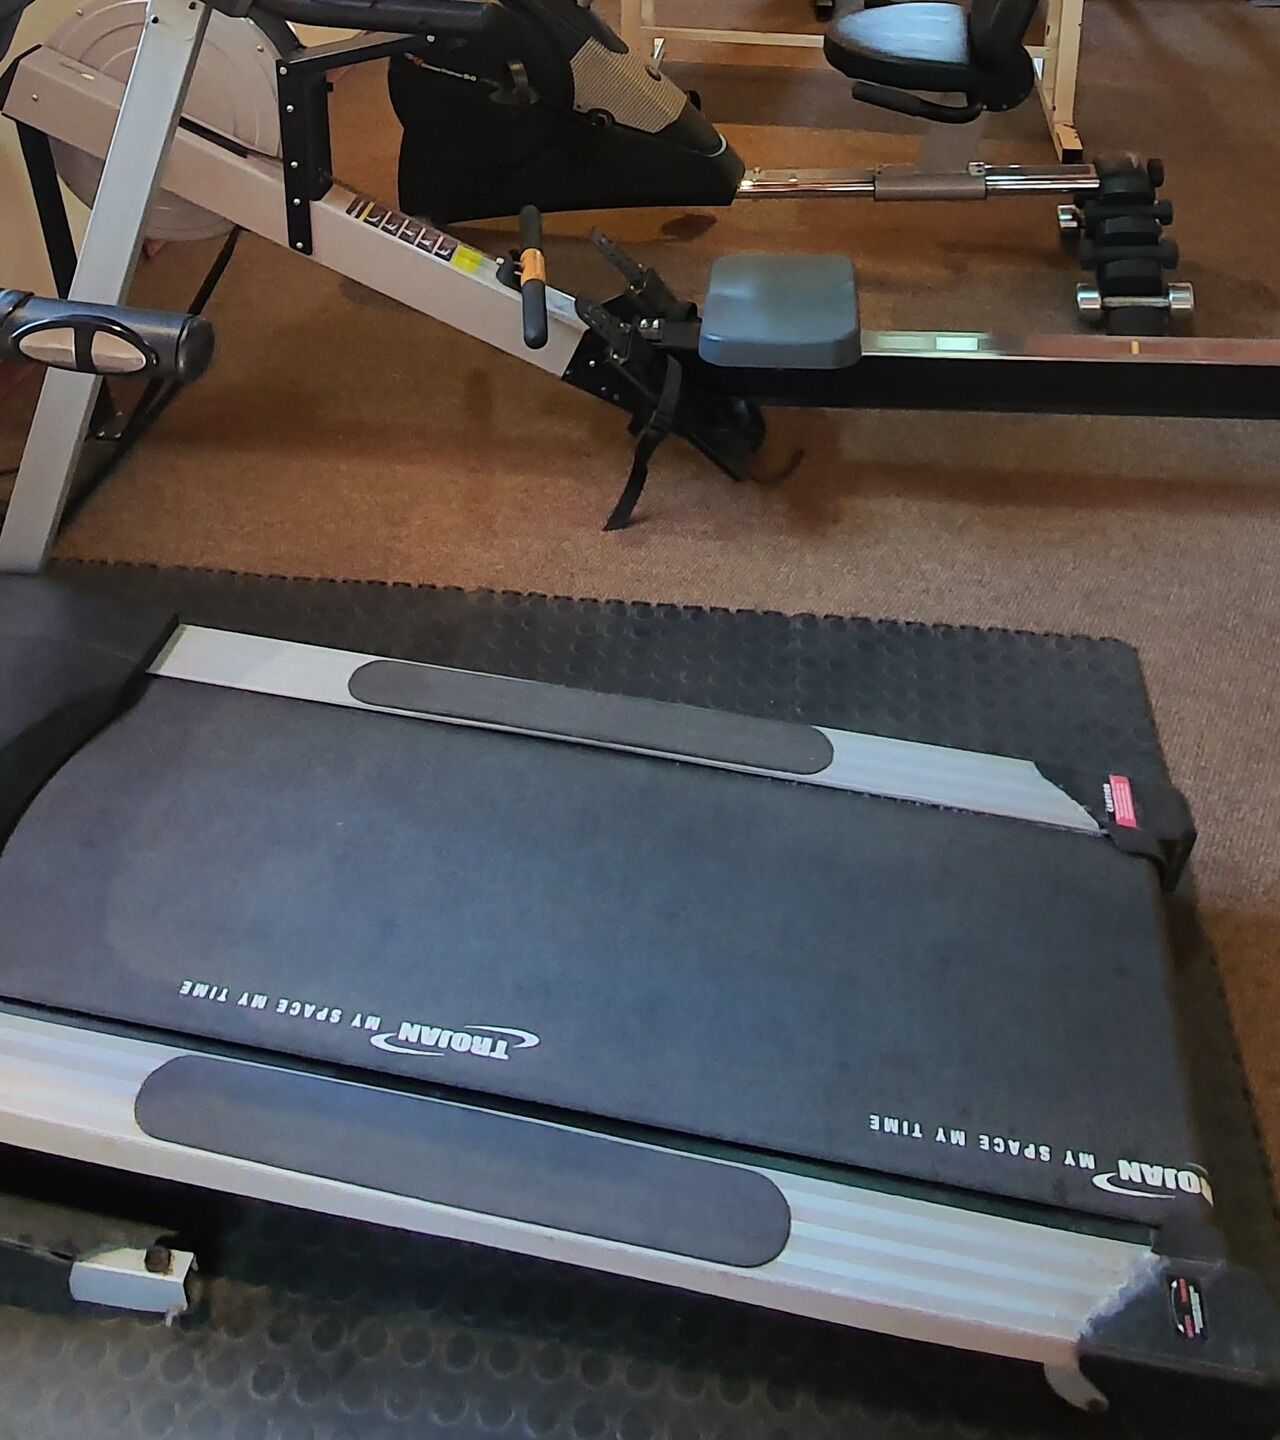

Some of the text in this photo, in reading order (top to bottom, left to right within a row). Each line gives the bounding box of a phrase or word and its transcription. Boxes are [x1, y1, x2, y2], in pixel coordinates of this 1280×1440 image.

[179, 980, 510, 1061] TROJAN MY SPACE MY TIME
[868, 1113, 923, 1139] TIME
[934, 1127, 967, 1147] MY
[978, 1133, 1052, 1162] SPACE
[1064, 1149, 1097, 1170] MY
